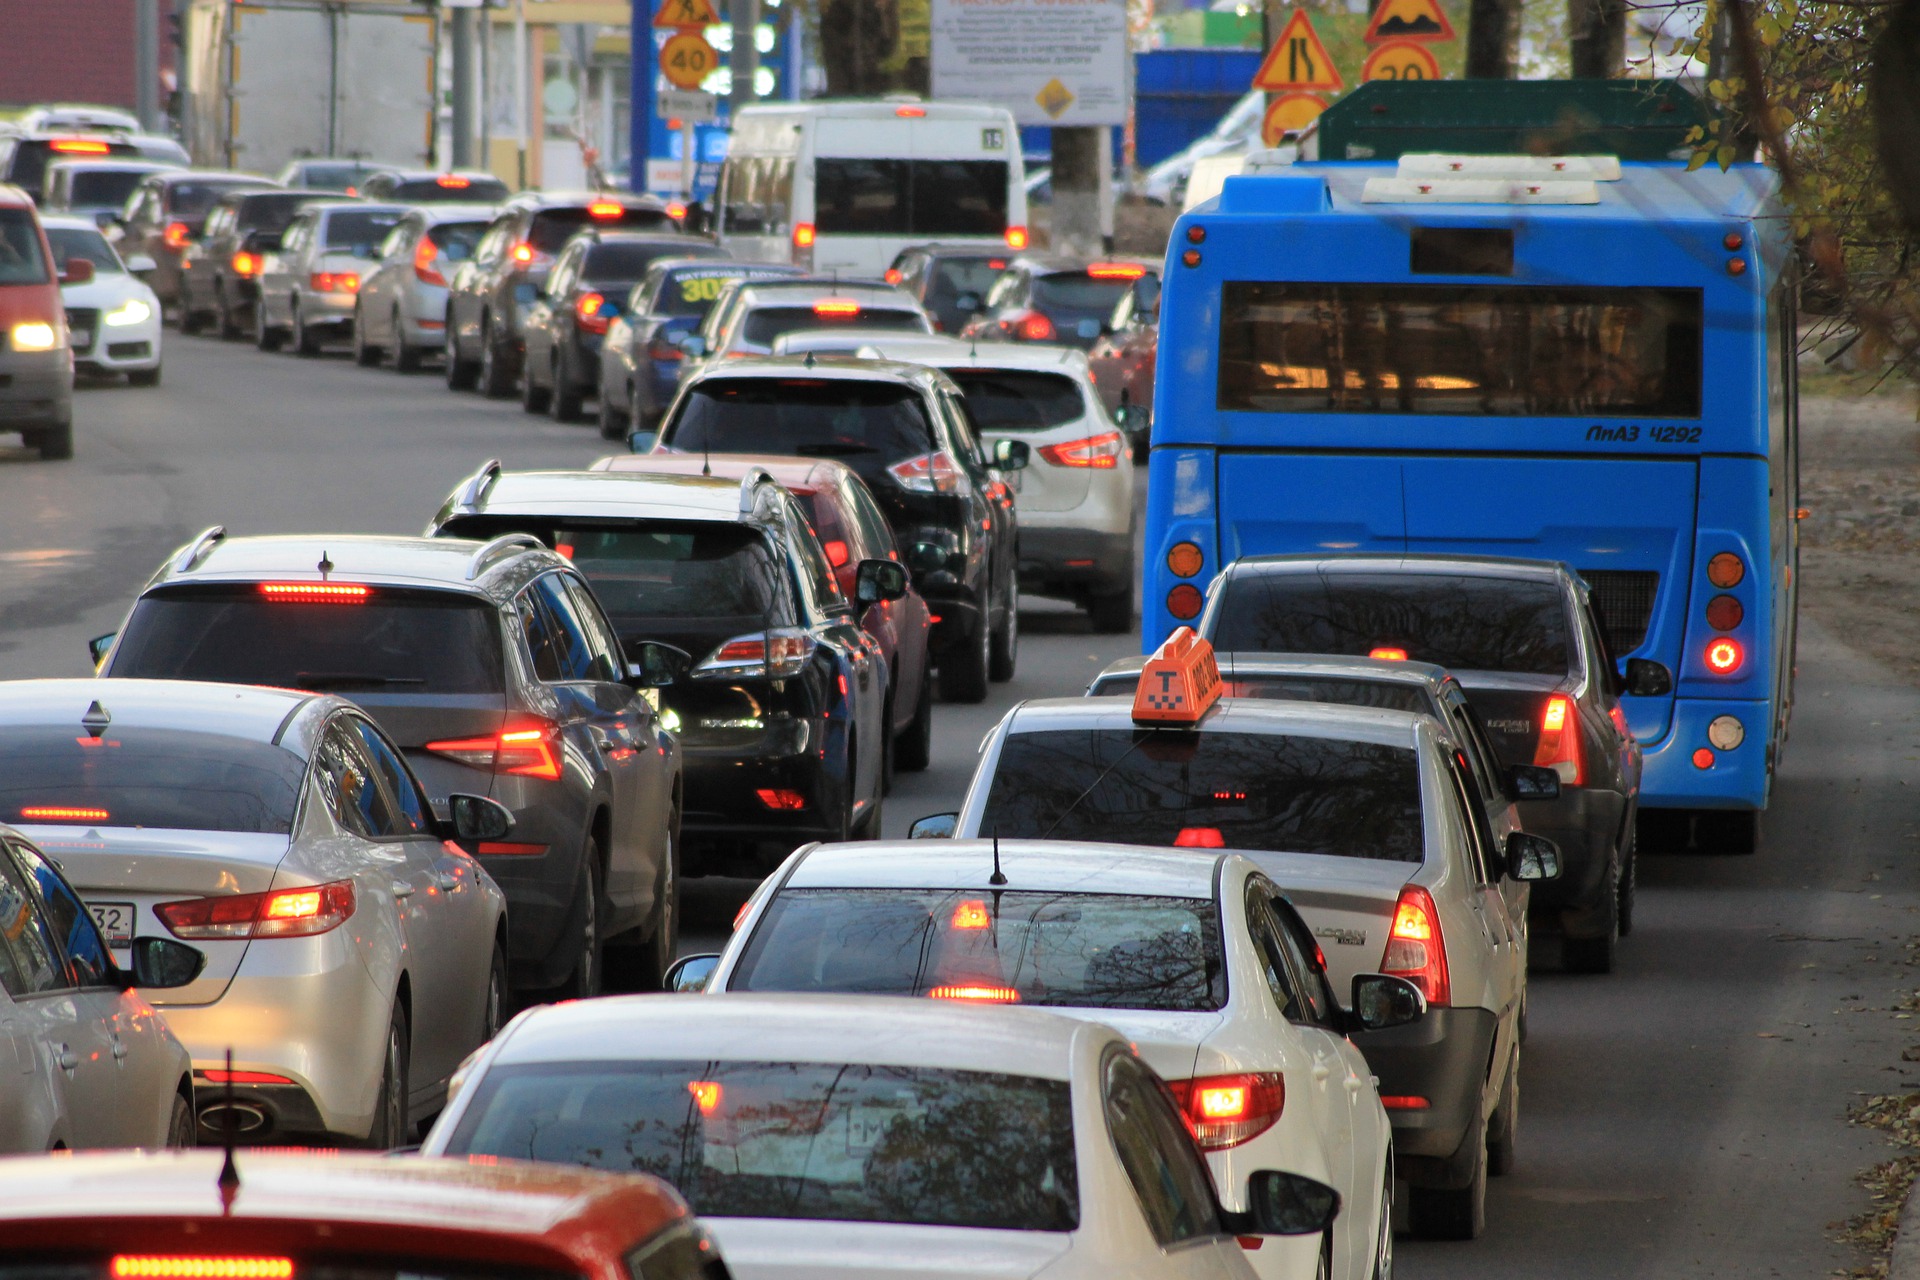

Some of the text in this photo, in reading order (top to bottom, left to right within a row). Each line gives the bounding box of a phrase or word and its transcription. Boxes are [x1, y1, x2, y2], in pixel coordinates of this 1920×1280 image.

[671, 48, 705, 71] 40
[1649, 426, 1703, 443] 4292
[93, 908, 122, 930] 32
